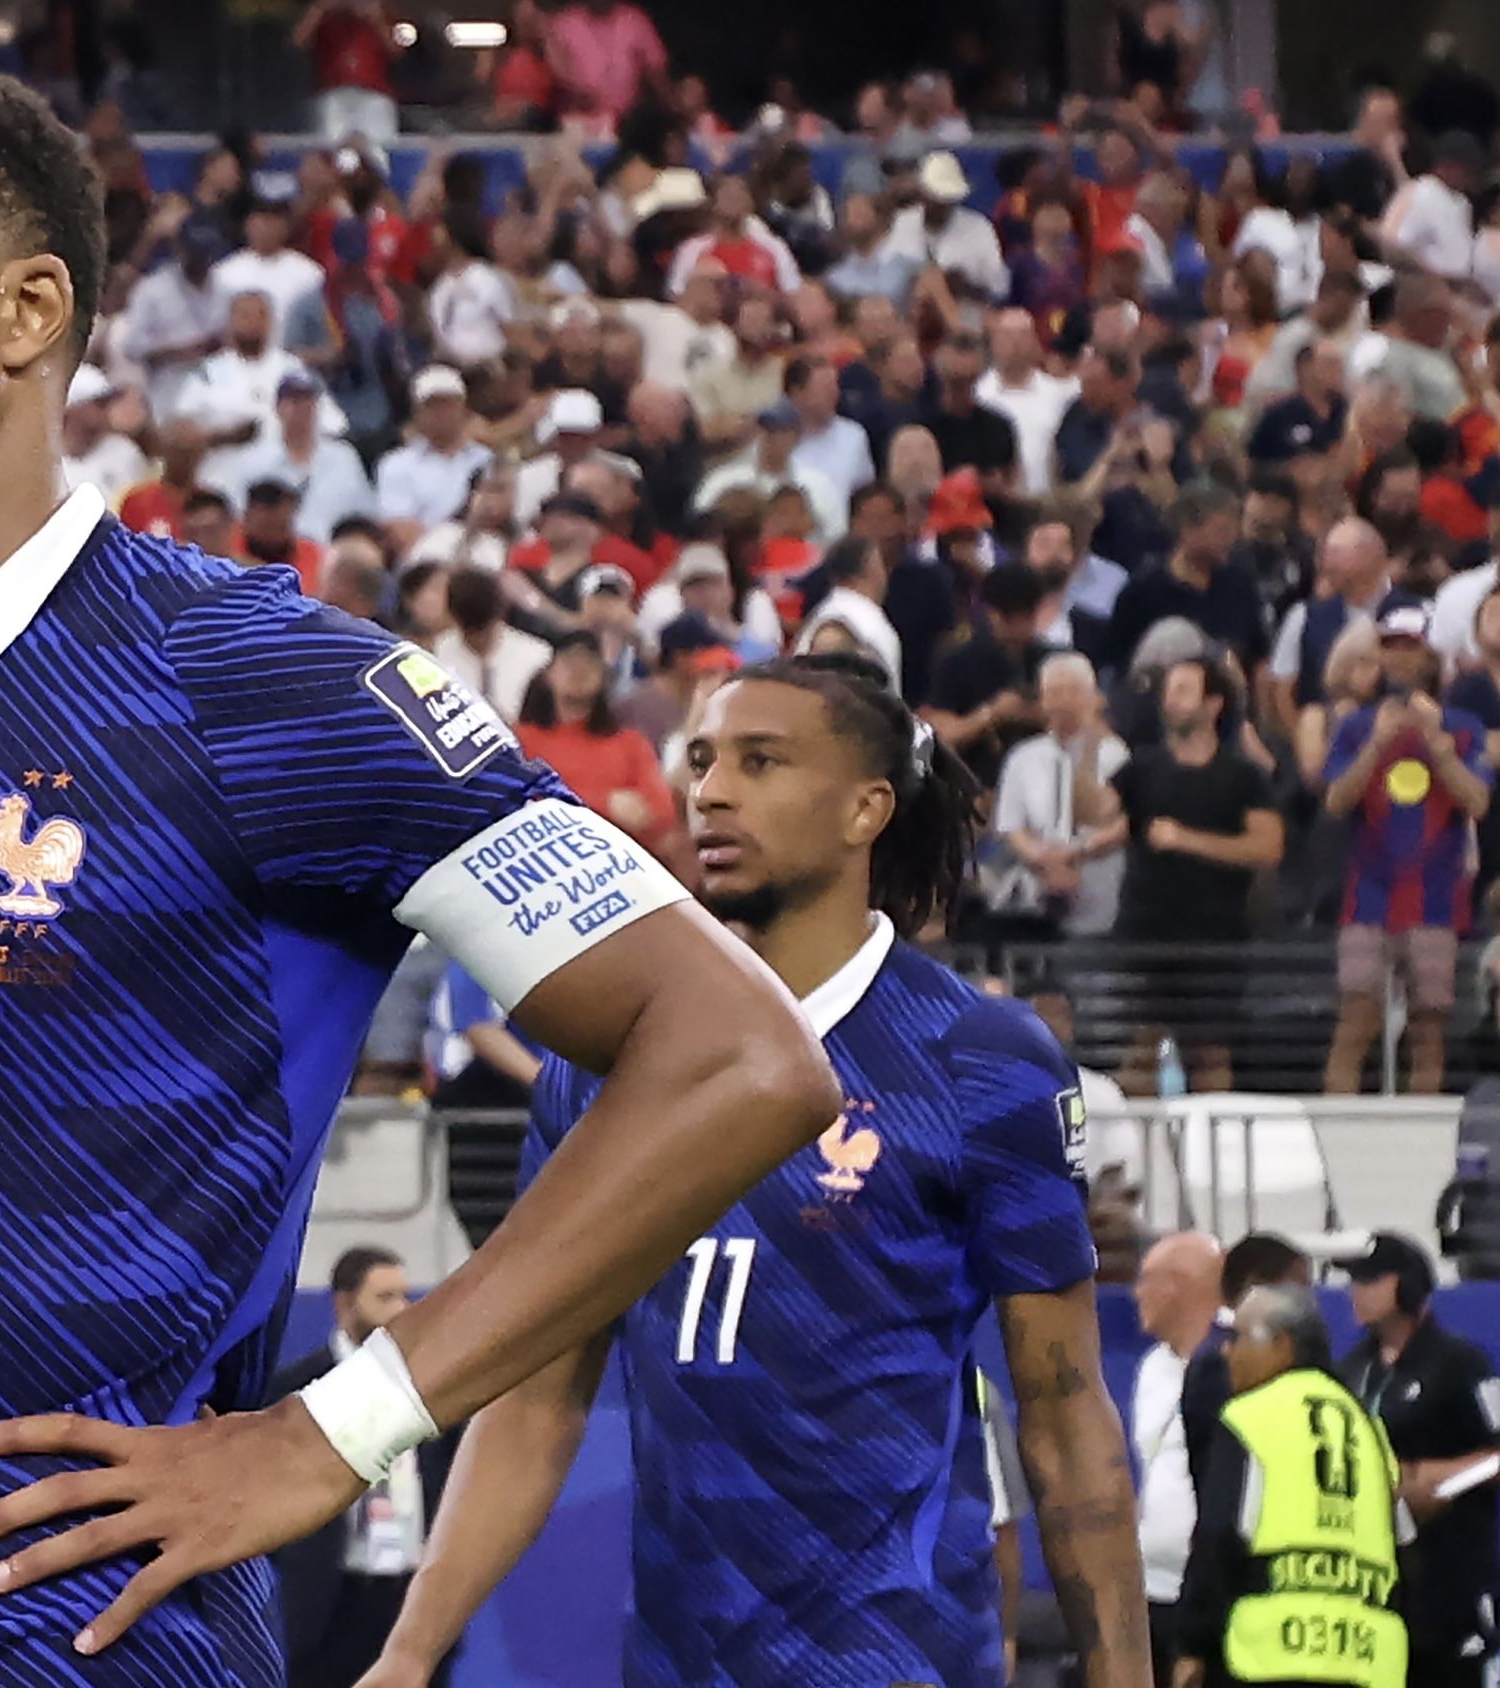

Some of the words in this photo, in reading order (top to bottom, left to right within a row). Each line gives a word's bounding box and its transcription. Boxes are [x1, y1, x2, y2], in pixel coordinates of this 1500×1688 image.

[460, 807, 583, 881] FOOTBALL
[481, 826, 611, 906] UNITES
[507, 902, 562, 936] the
[555, 848, 646, 904] World
[571, 892, 630, 935] FIFA
[674, 1237, 757, 1365] 11
